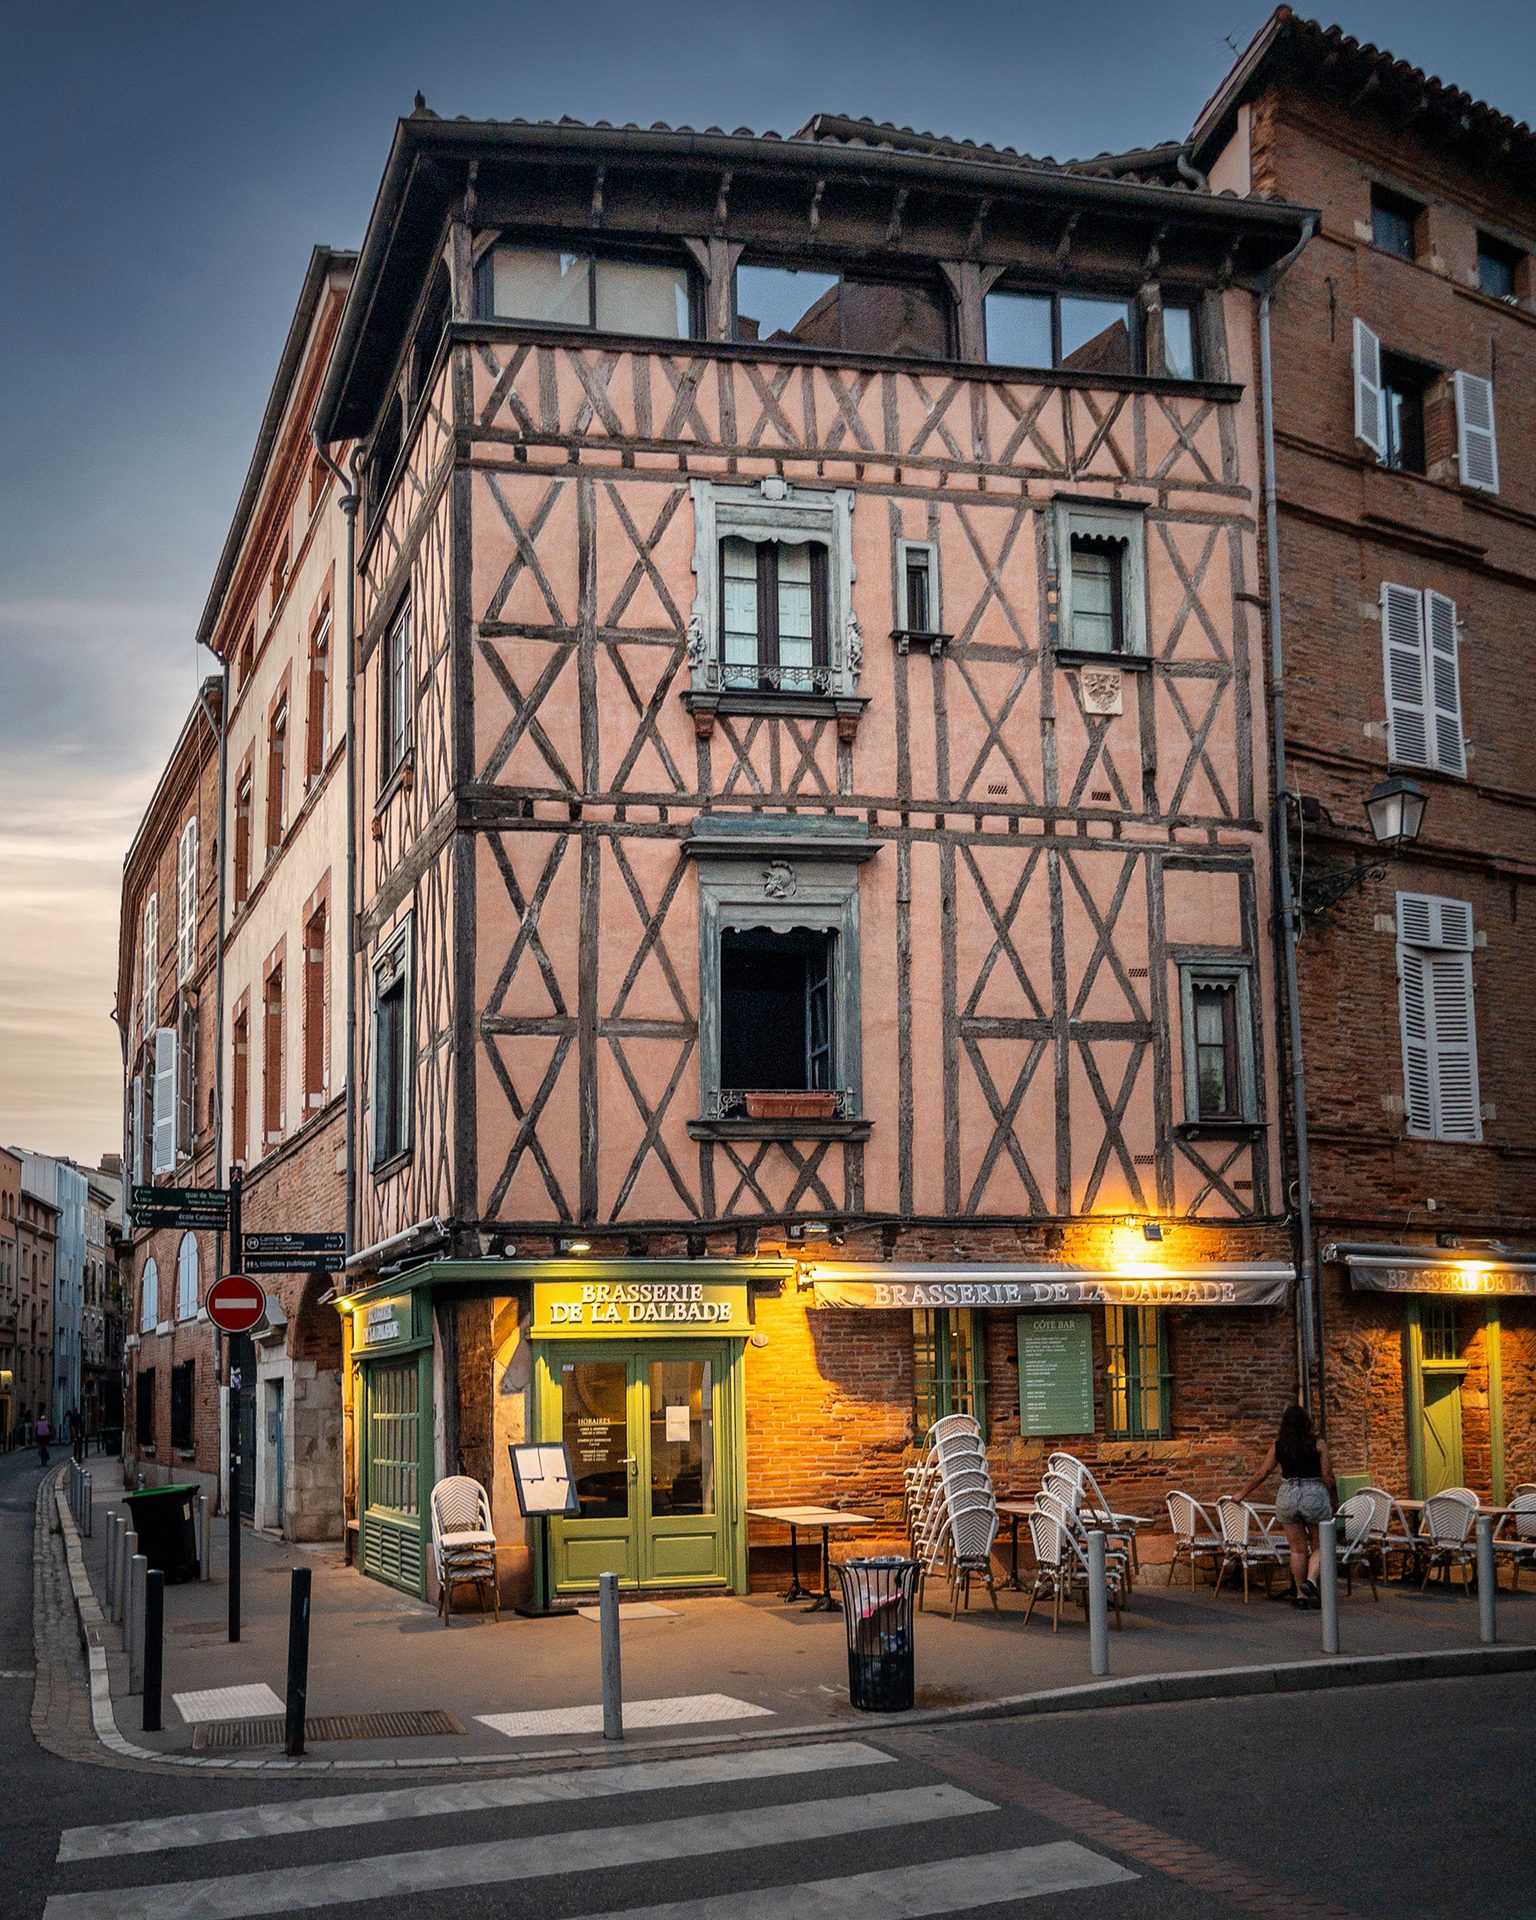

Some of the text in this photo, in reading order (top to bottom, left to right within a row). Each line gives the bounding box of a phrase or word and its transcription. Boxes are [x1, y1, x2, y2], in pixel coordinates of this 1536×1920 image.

[259, 1260, 317, 1268] toilettes publiques
[580, 1283, 704, 1304] BRASSERIE
[873, 1281, 1236, 1306] BRASSERIE DE LA DALBADE
[1482, 1272, 1506, 1293] DE
[1508, 1273, 1531, 1294] LA
[550, 1302, 733, 1324] DE LA DALBADE
[1058, 1320, 1076, 1329] BAR
[577, 1417, 611, 1425] HORAIRES
